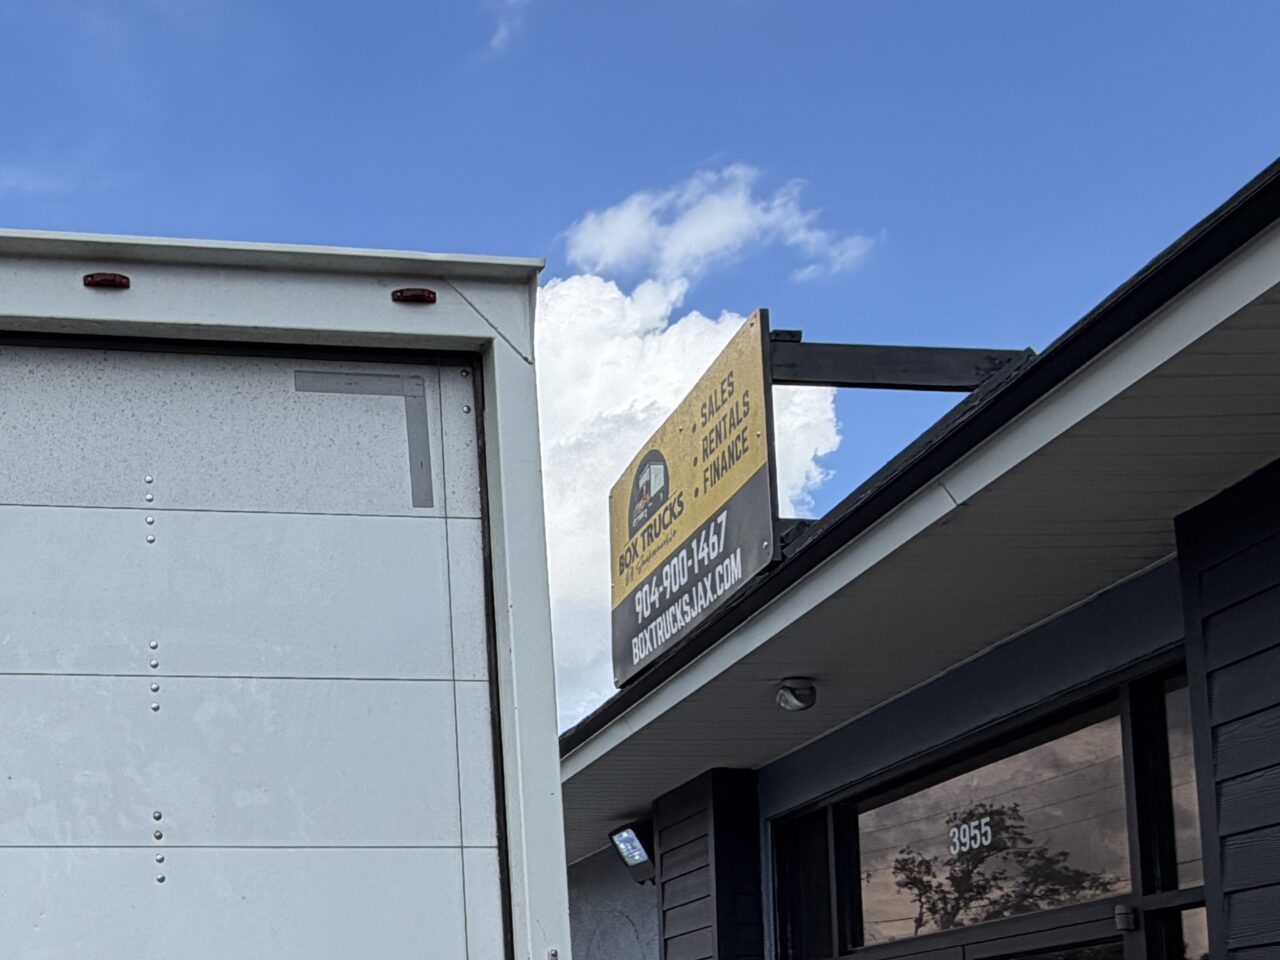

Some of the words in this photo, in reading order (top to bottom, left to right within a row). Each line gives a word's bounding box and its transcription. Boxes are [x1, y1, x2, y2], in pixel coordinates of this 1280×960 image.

[701, 370, 734, 428] SALES
[702, 390, 750, 462] RENTALS
[704, 426, 749, 494] FINANCE
[619, 537, 639, 576] BOX
[641, 491, 685, 551] TRUCKS
[635, 510, 727, 624] 904-900-1467
[632, 547, 742, 665] BOXTRUCKSJAX.COM
[949, 816, 992, 855] 3955
